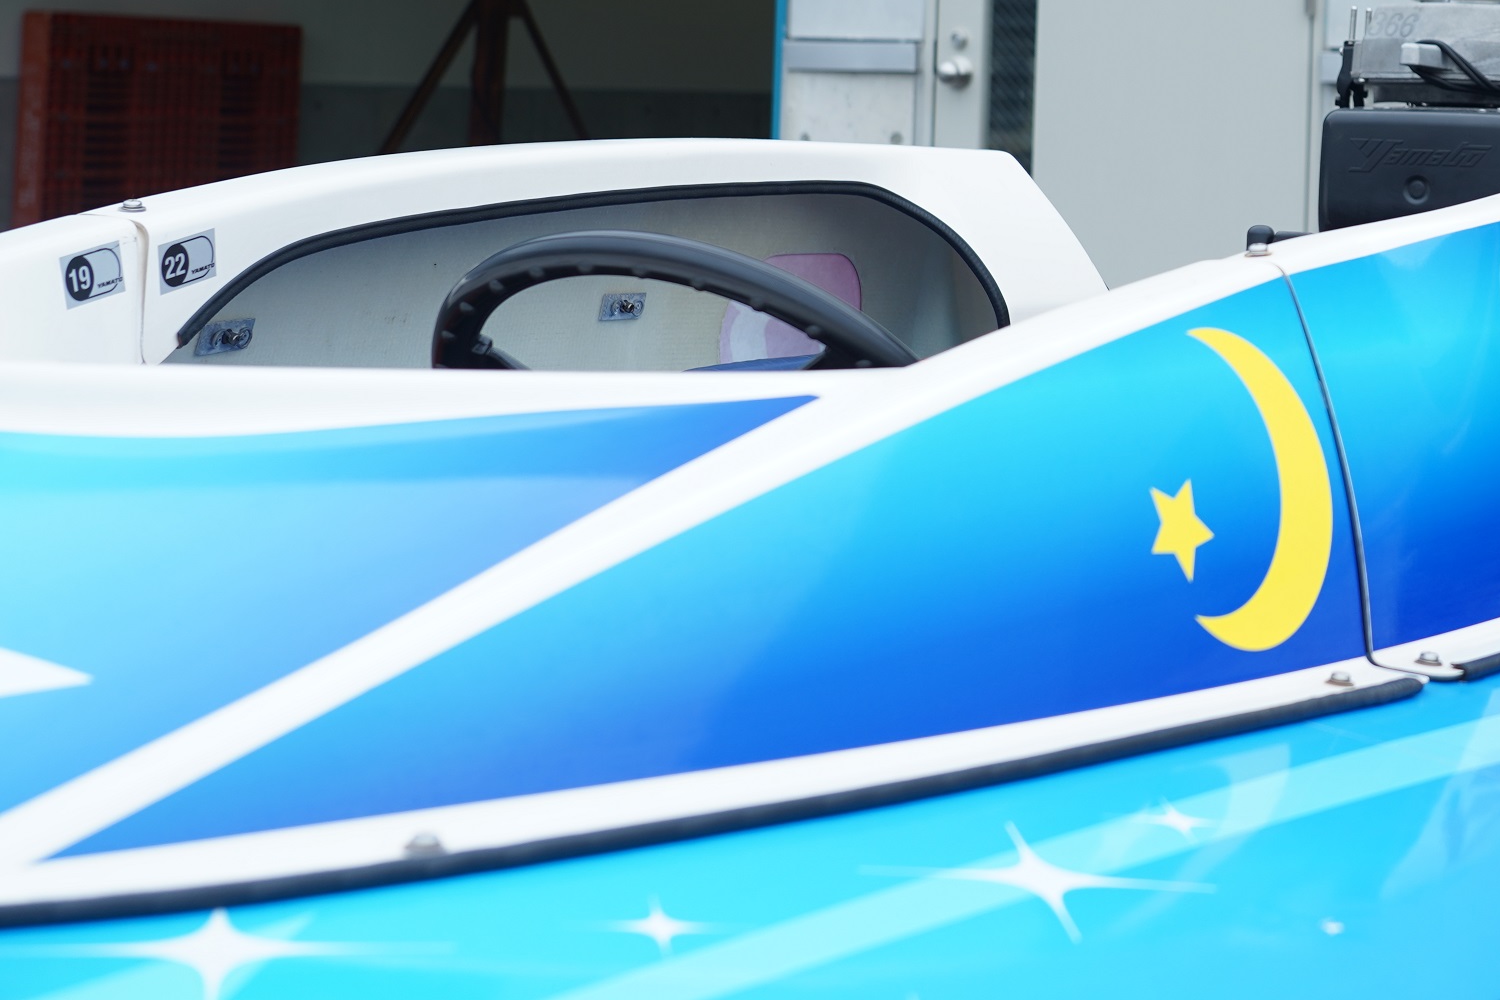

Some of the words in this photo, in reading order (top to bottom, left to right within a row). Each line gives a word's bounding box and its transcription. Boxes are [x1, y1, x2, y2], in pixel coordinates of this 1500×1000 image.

[1367, 11, 1420, 38] 366
[68, 264, 92, 293] 19
[164, 252, 187, 281] 22
[191, 262, 215, 274] YAMATO
[98, 276, 123, 288] YAMATO
